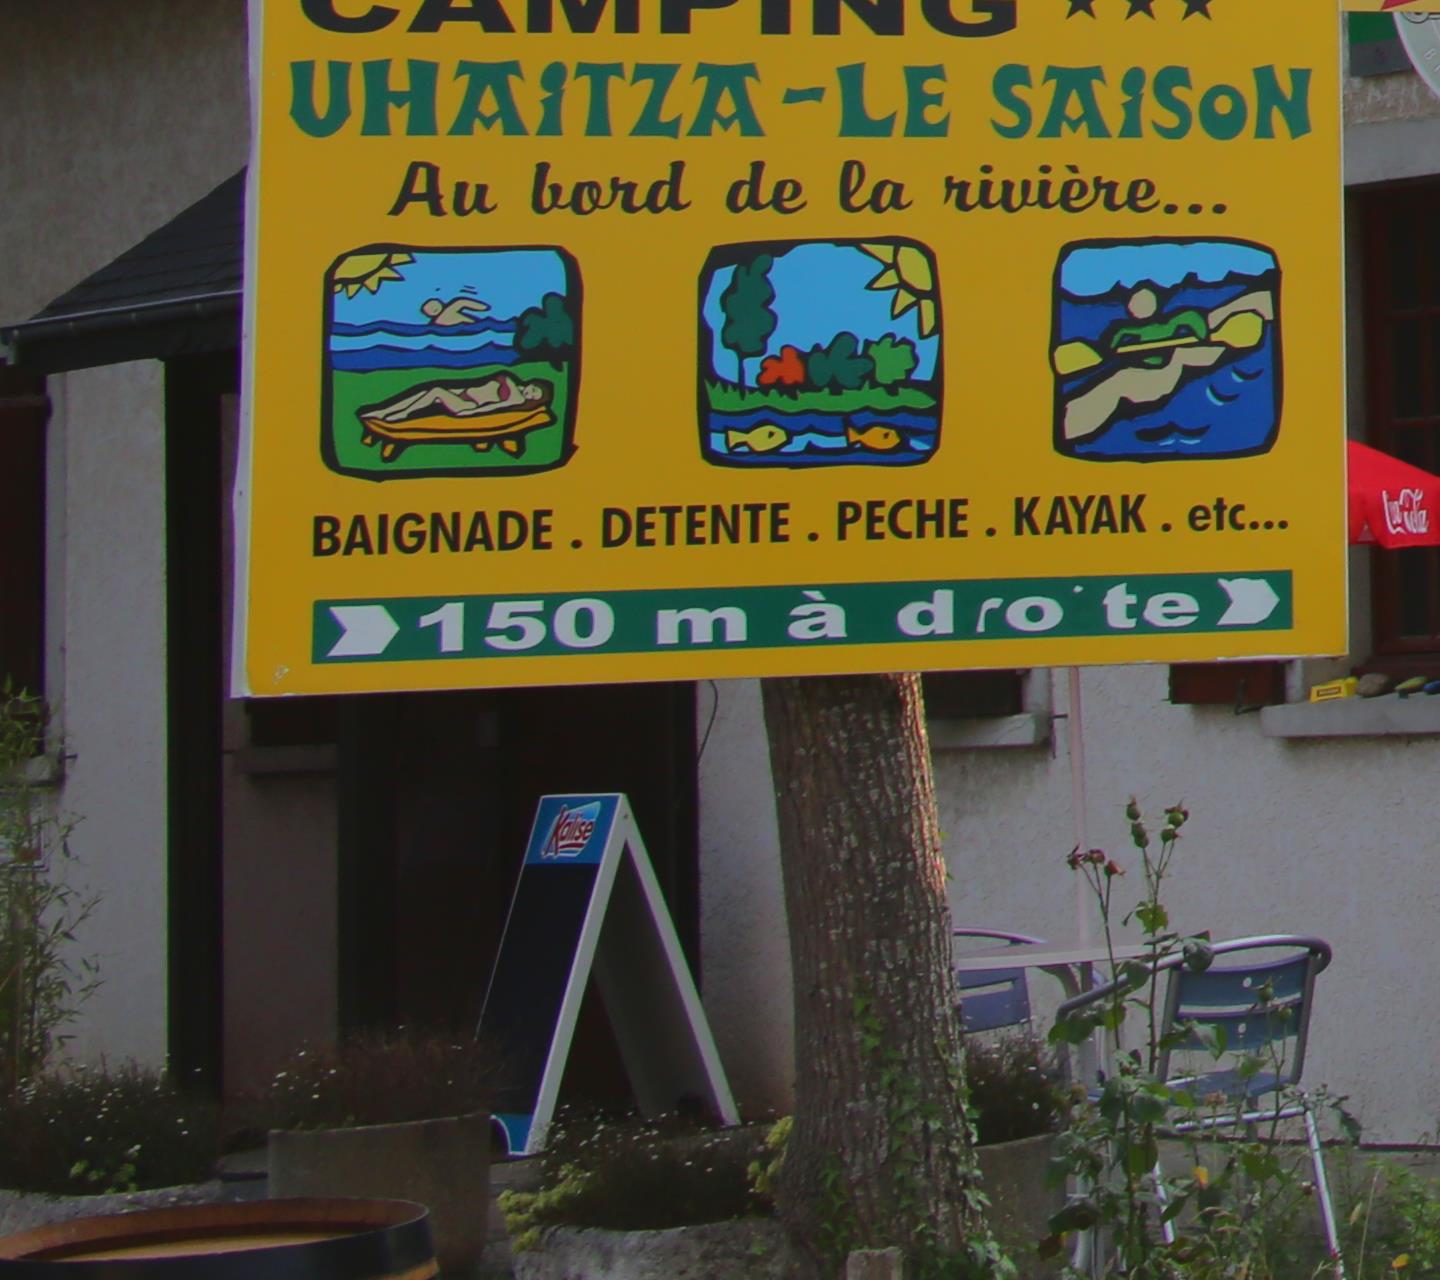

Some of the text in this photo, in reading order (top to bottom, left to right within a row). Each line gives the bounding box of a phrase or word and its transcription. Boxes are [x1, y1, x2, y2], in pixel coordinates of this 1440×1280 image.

[990, 63, 1312, 140] SAISON
[387, 160, 498, 217] Au
[531, 159, 692, 216] bord
[725, 159, 808, 215] de
[839, 159, 913, 214] la
[311, 493, 1290, 557] BAIGNADE DETENTE PECHE KAYAK etc...
[418, 597, 616, 654] 150
[656, 606, 748, 646] m
[787, 590, 848, 641] à
[542, 804, 596, 857] Kalise
